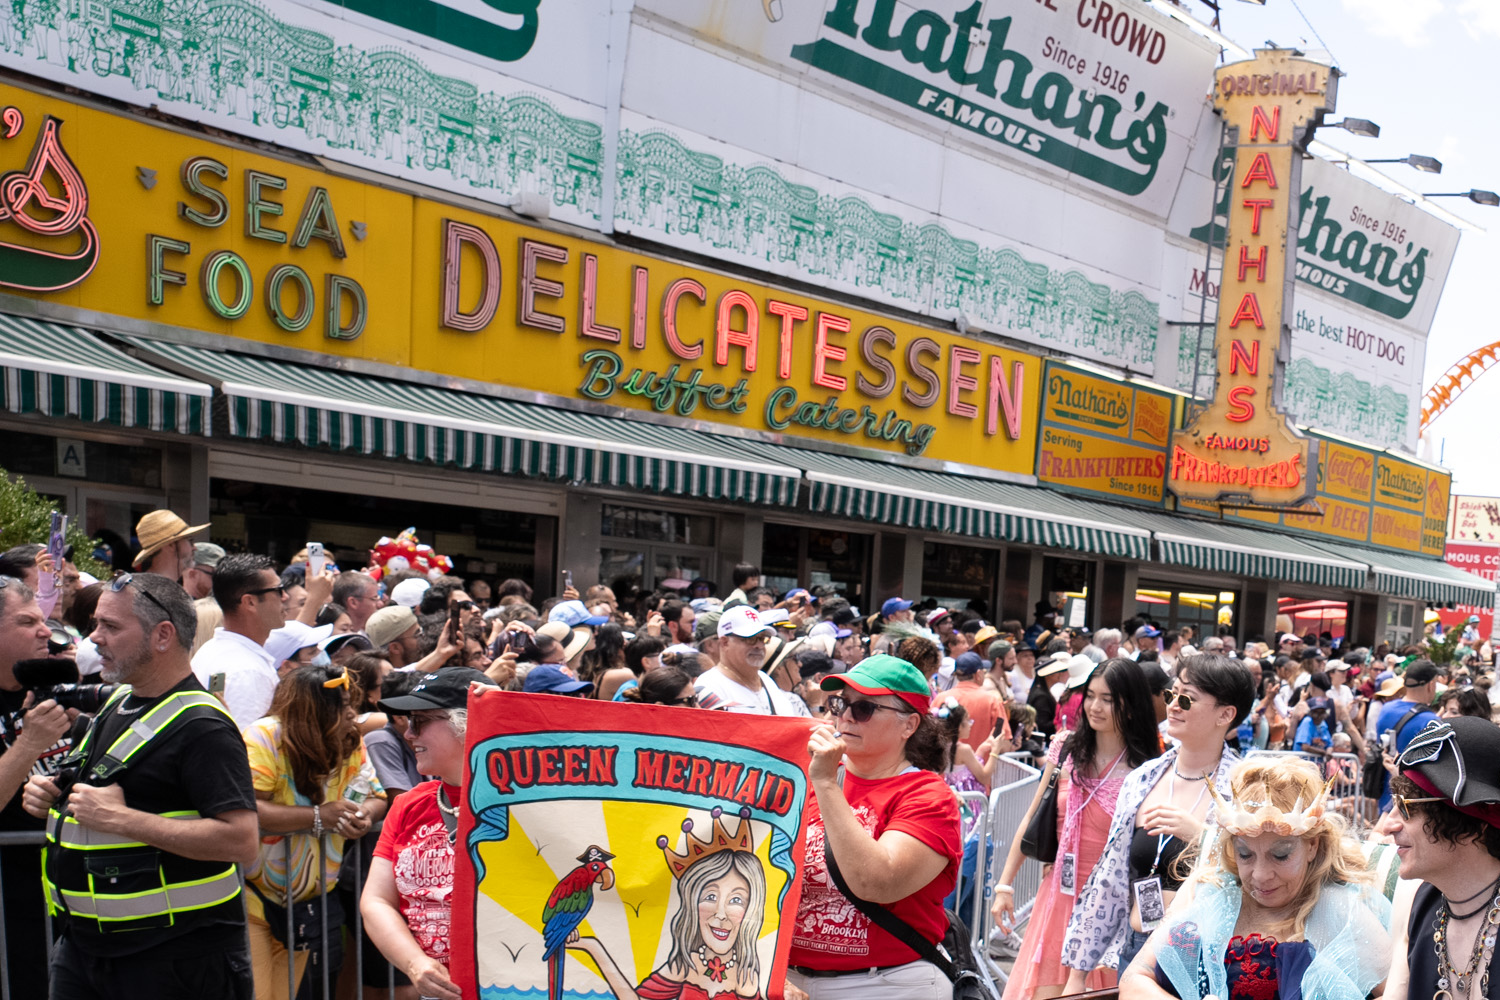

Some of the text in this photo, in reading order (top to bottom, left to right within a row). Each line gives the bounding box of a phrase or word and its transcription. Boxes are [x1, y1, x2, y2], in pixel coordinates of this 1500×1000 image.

[1077, 0, 1166, 65] CROWD
[1042, 36, 1131, 95] Since 1916
[1221, 70, 1320, 97] ORIGINAL
[917, 87, 1047, 153] FAMOUS
[177, 156, 348, 259] SEA
[1350, 205, 1407, 244] Since 1916
[1296, 185, 1429, 296] than's
[1224, 104, 1282, 424] NATHANS
[1295, 262, 1349, 294] MOUS
[146, 233, 369, 342] FOOD
[440, 217, 1025, 441] DELICATESSEN
[1296, 310, 1315, 333] the
[1319, 316, 1344, 343] best
[1346, 326, 1375, 354] HOT
[1377, 337, 1405, 366] DOG
[579, 349, 936, 457] Buffet Catering
[1048, 375, 1129, 424] Nathan's
[62, 444, 81, 466] A
[1044, 430, 1083, 452] Serving
[1204, 434, 1270, 452] FAMOUS
[1039, 449, 1165, 479] FRANKFURTERS
[1109, 477, 1135, 493] Since
[1170, 445, 1301, 488] FRANKFURTERS
[1377, 463, 1424, 496] Nathan's
[1331, 504, 1369, 534] BEER
[485, 745, 796, 817] QUEEN MERMAID
[428, 848, 446, 858] THE
[985, 856, 993, 898] YPD
[811, 942, 828, 951] TICKET
[829, 945, 847, 953] TICKET
[849, 946, 867, 954] TICKET
[820, 922, 868, 940] BROOKLYN
